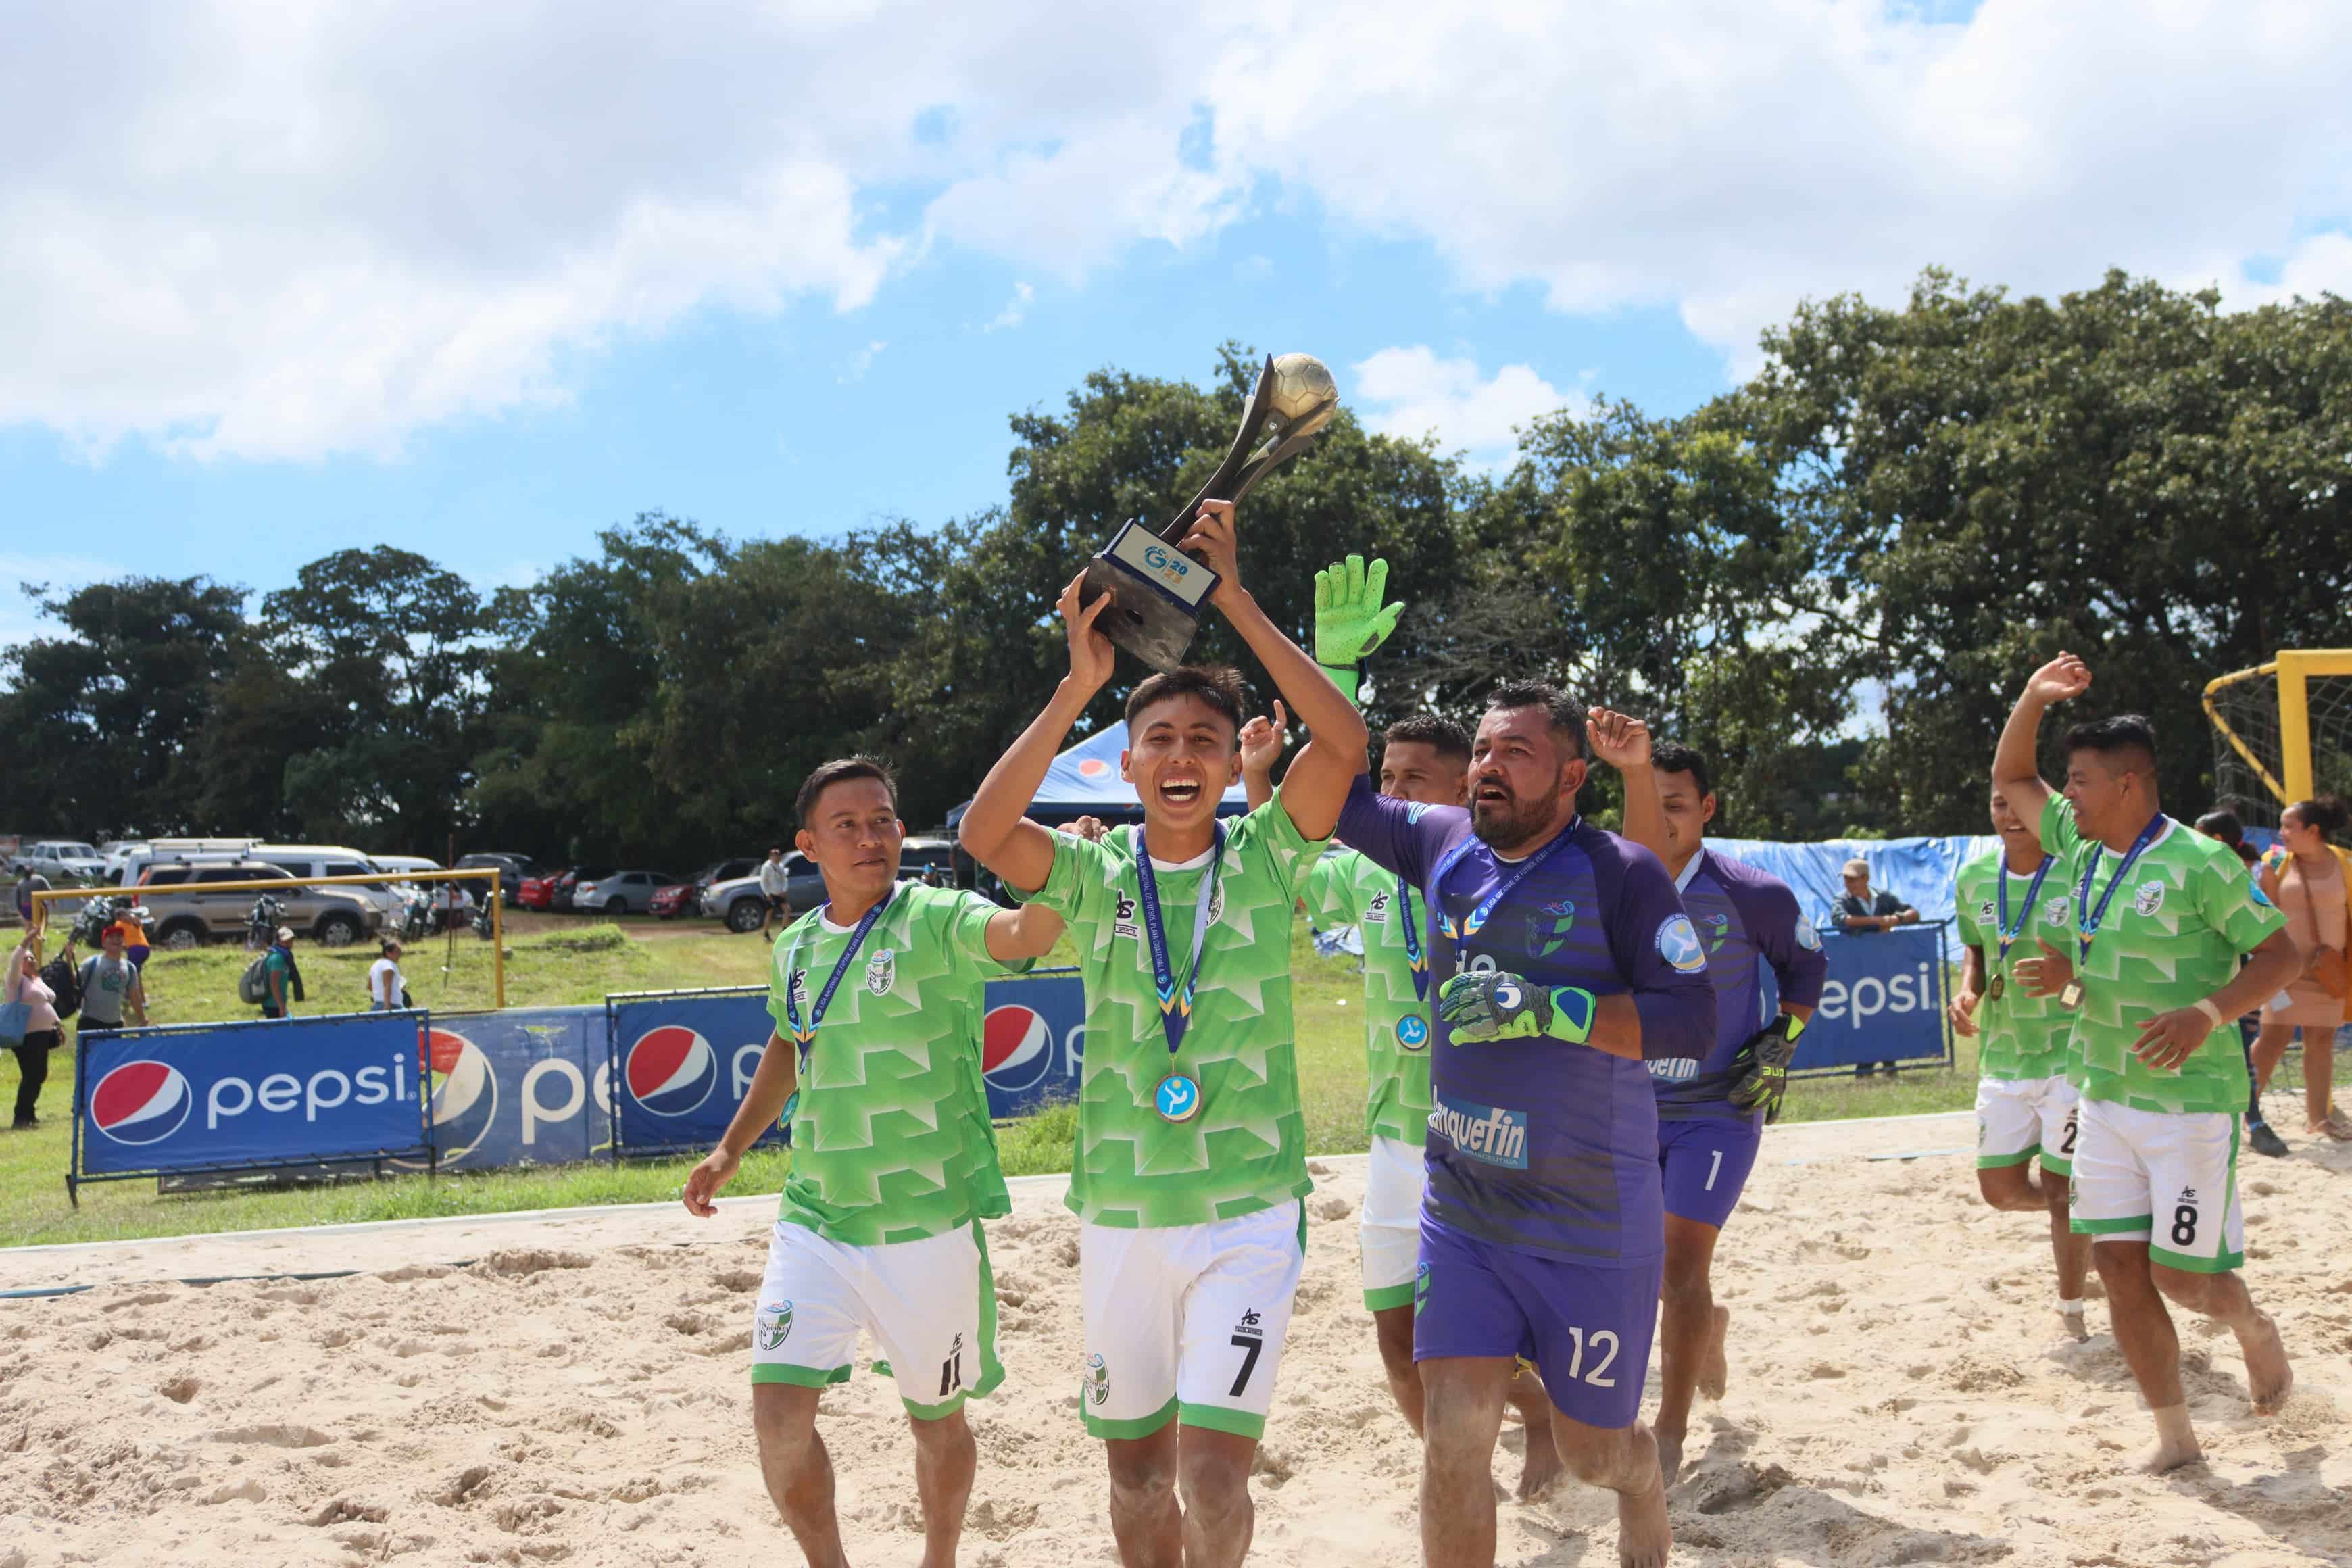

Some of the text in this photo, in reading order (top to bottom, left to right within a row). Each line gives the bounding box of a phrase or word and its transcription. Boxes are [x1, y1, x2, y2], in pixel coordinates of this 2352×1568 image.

[1140, 866, 1149, 892] NACIONAL
[1144, 891, 1152, 900] DE
[1117, 926, 1137, 935] SPORTS
[1146, 900, 1155, 922] FUTBOL
[1150, 922, 1158, 939] PLAYA
[1152, 939, 1165, 973] GUATEMALA
[1818, 962, 1930, 1029] epsi
[207, 1052, 405, 1130] pepsi
[1705, 1150, 1723, 1191] 1
[2171, 1205, 2198, 1246] 8
[939, 1351, 961, 1396] 11
[1229, 1334, 1263, 1397] 7
[1569, 1326, 1619, 1388] 12
